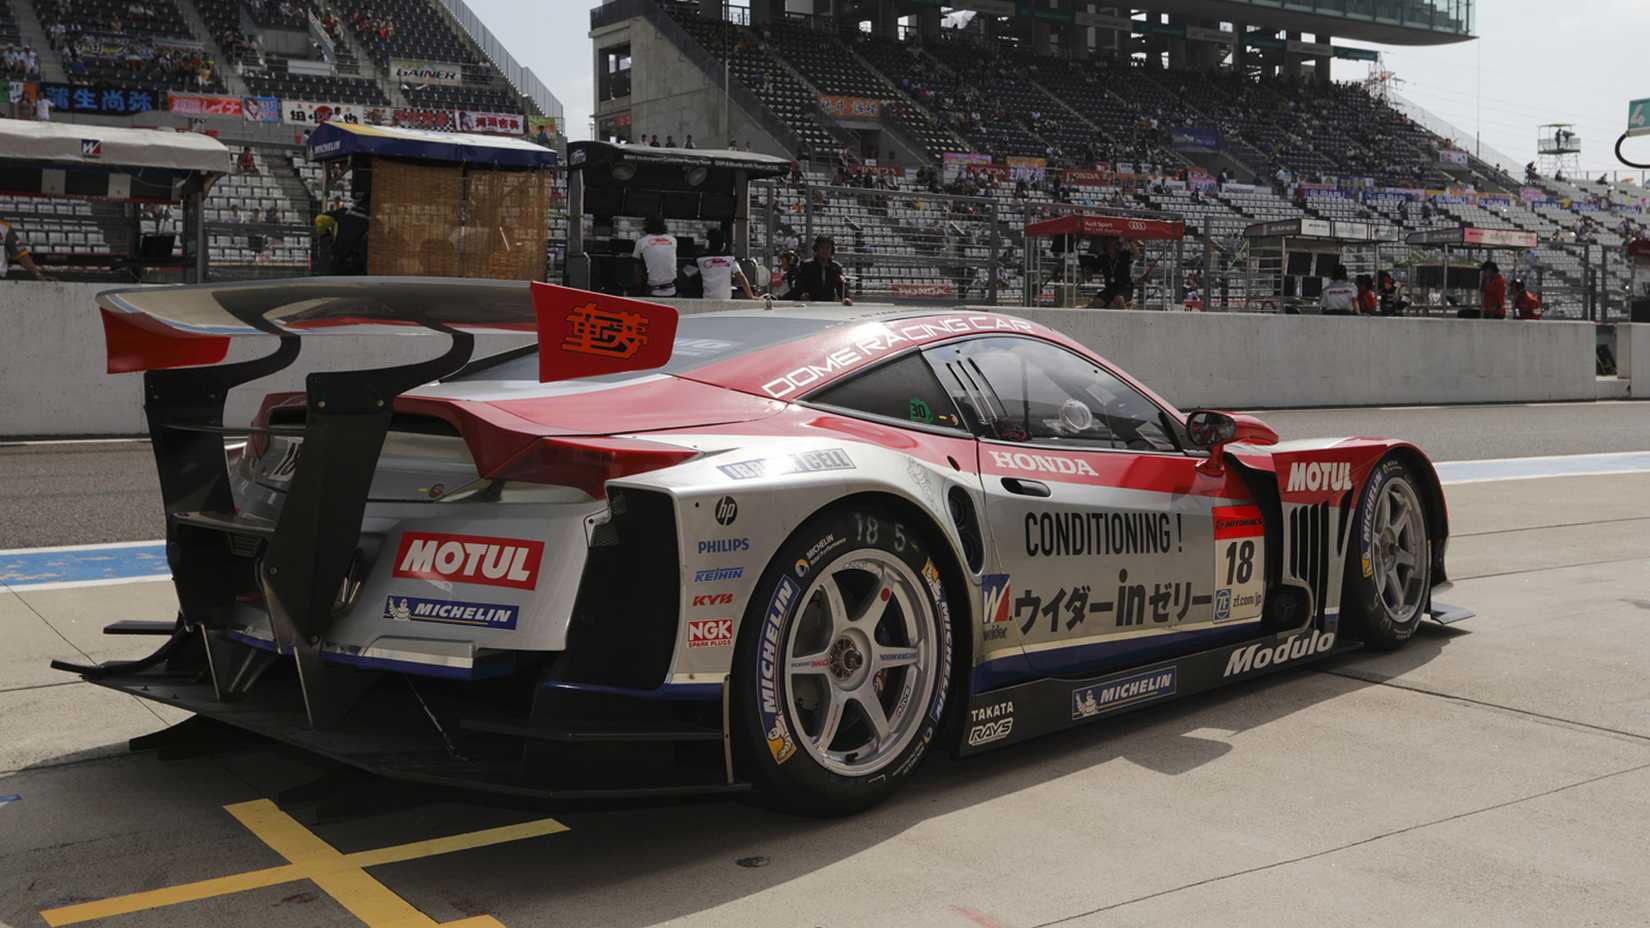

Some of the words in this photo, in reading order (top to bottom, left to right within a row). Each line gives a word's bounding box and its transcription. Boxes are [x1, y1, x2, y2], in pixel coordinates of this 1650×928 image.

[396, 67, 457, 81] GAINER
[762, 347, 862, 399] DOME
[858, 316, 970, 356] RACING
[972, 317, 1032, 335] CAR
[910, 403, 926, 418] 30
[988, 450, 1099, 477] HONDA
[1287, 461, 1353, 492] MOTUL
[717, 499, 736, 523] hp
[1362, 471, 1383, 542] MICHELIN
[855, 513, 880, 545] 18
[1024, 511, 1171, 557] CONDITIONING
[1177, 512, 1183, 553] !
[698, 537, 750, 555] PHILIPS
[805, 532, 835, 560] MICHELIN
[400, 539, 533, 582] MOTUL
[1226, 539, 1256, 586] 18
[693, 567, 745, 583] KEIHIN
[413, 602, 513, 624] MICHELIN
[692, 593, 735, 607] KYB
[688, 620, 733, 641] NGK
[688, 640, 710, 649] SPARK
[711, 639, 733, 648] PLUGS
[761, 580, 793, 714] MICHELIN
[1223, 629, 1336, 677] Modulo
[1099, 673, 1173, 704] MICHELIN
[970, 700, 1015, 722] TAKATA
[968, 718, 1014, 745] RAYS
